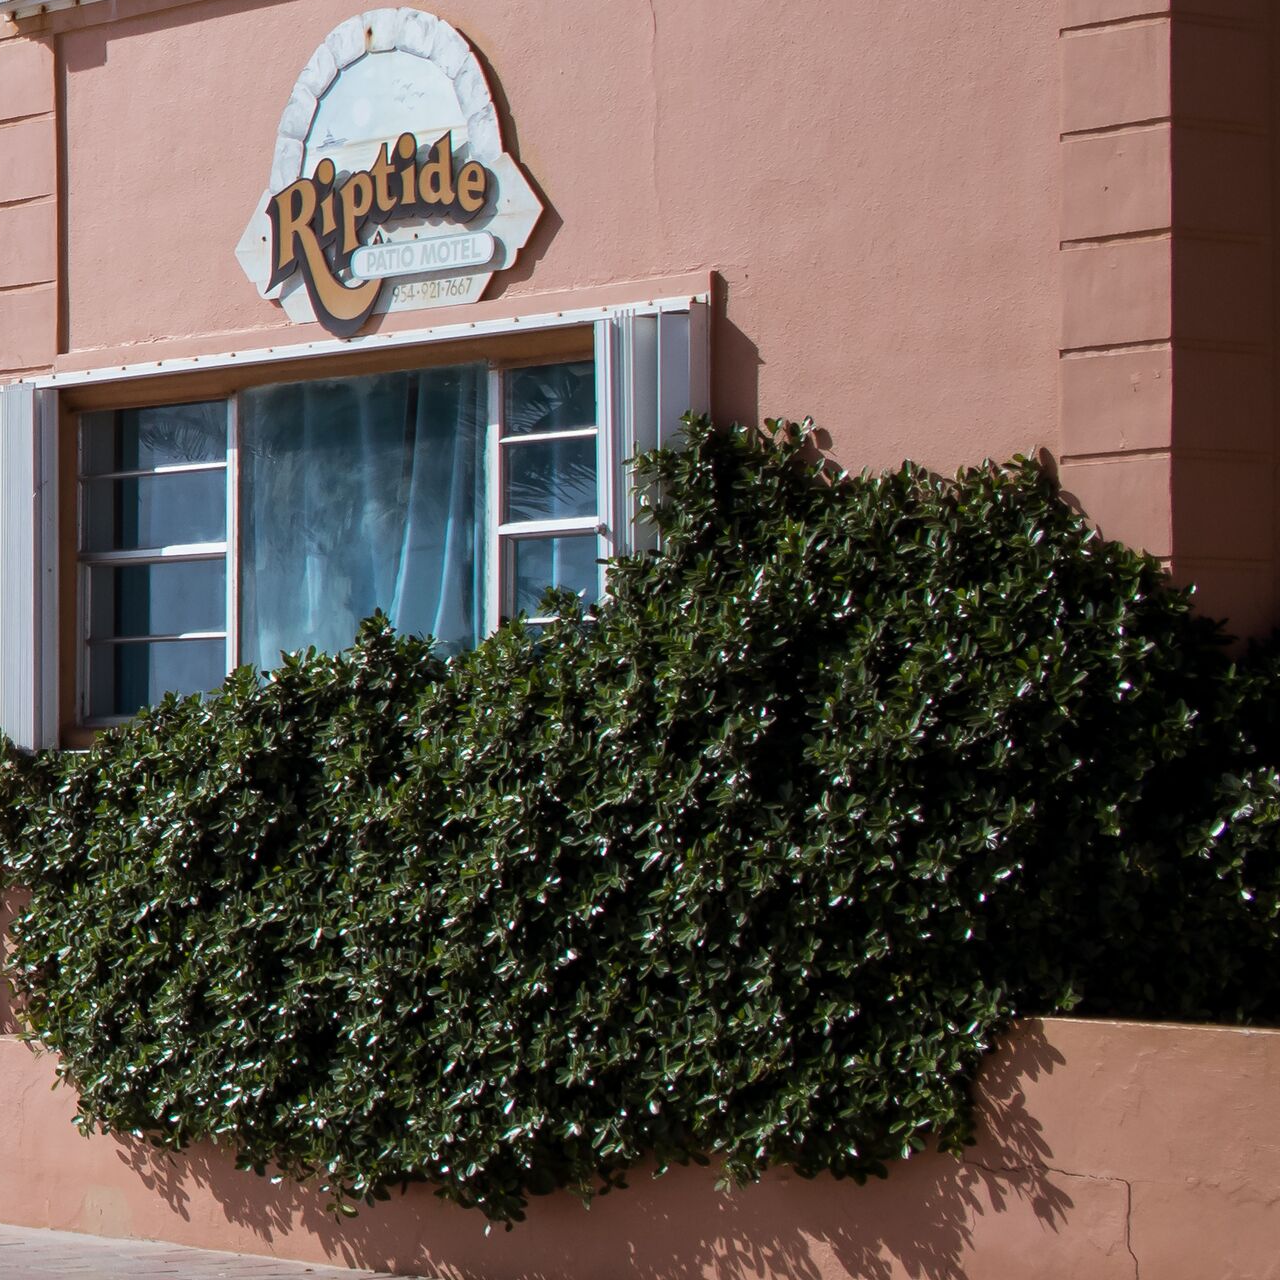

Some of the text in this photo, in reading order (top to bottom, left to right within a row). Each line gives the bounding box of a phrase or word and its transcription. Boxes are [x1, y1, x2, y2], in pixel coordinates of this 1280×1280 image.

[265, 130, 486, 332] Riptide
[366, 238, 481, 272] PATIO MOTEL
